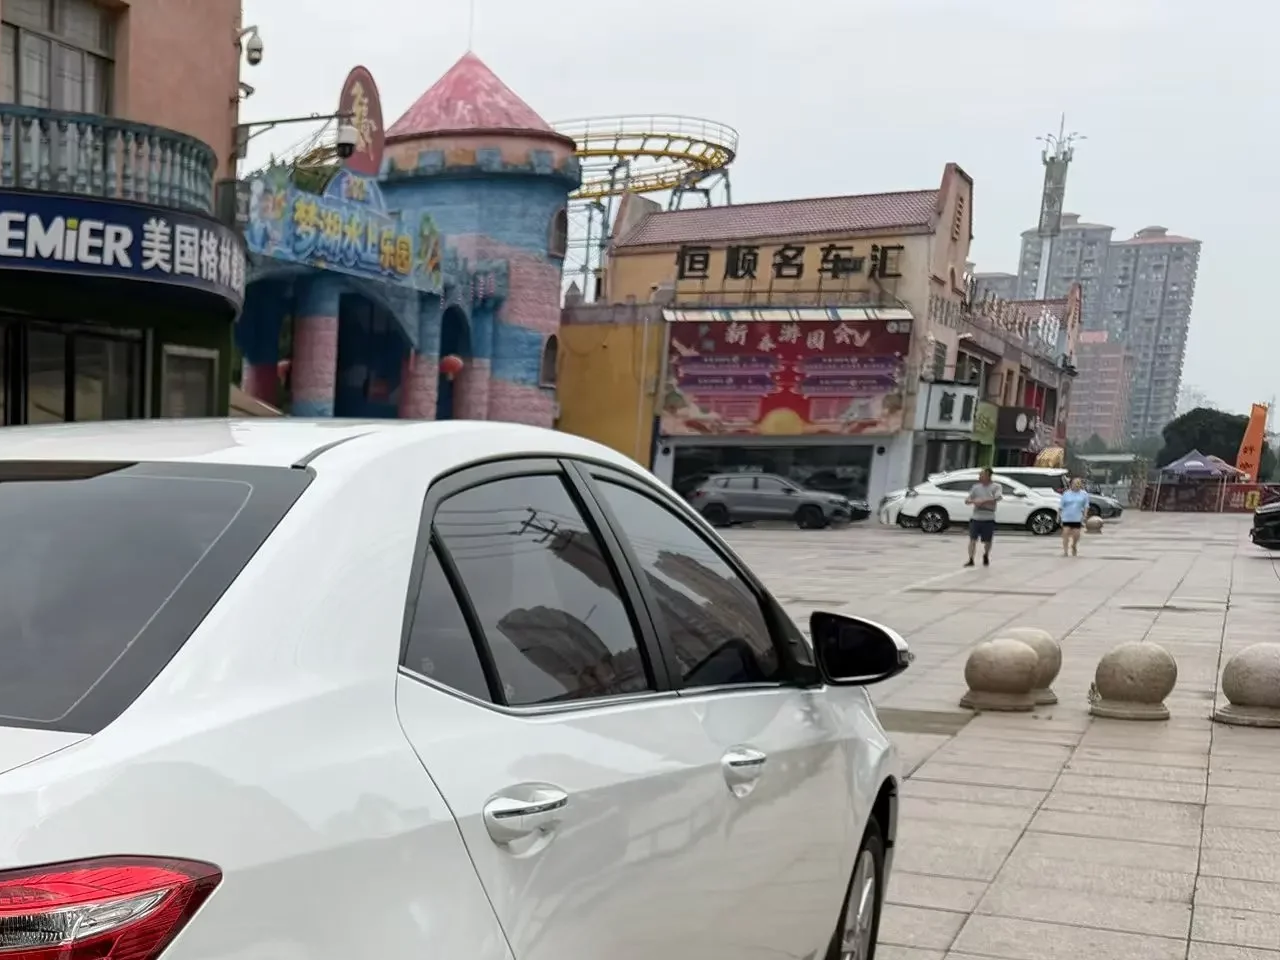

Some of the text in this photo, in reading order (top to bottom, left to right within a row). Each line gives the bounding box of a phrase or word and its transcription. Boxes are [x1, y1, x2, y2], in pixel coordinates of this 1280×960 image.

[676, 244, 904, 280] 恒顺名车汇
